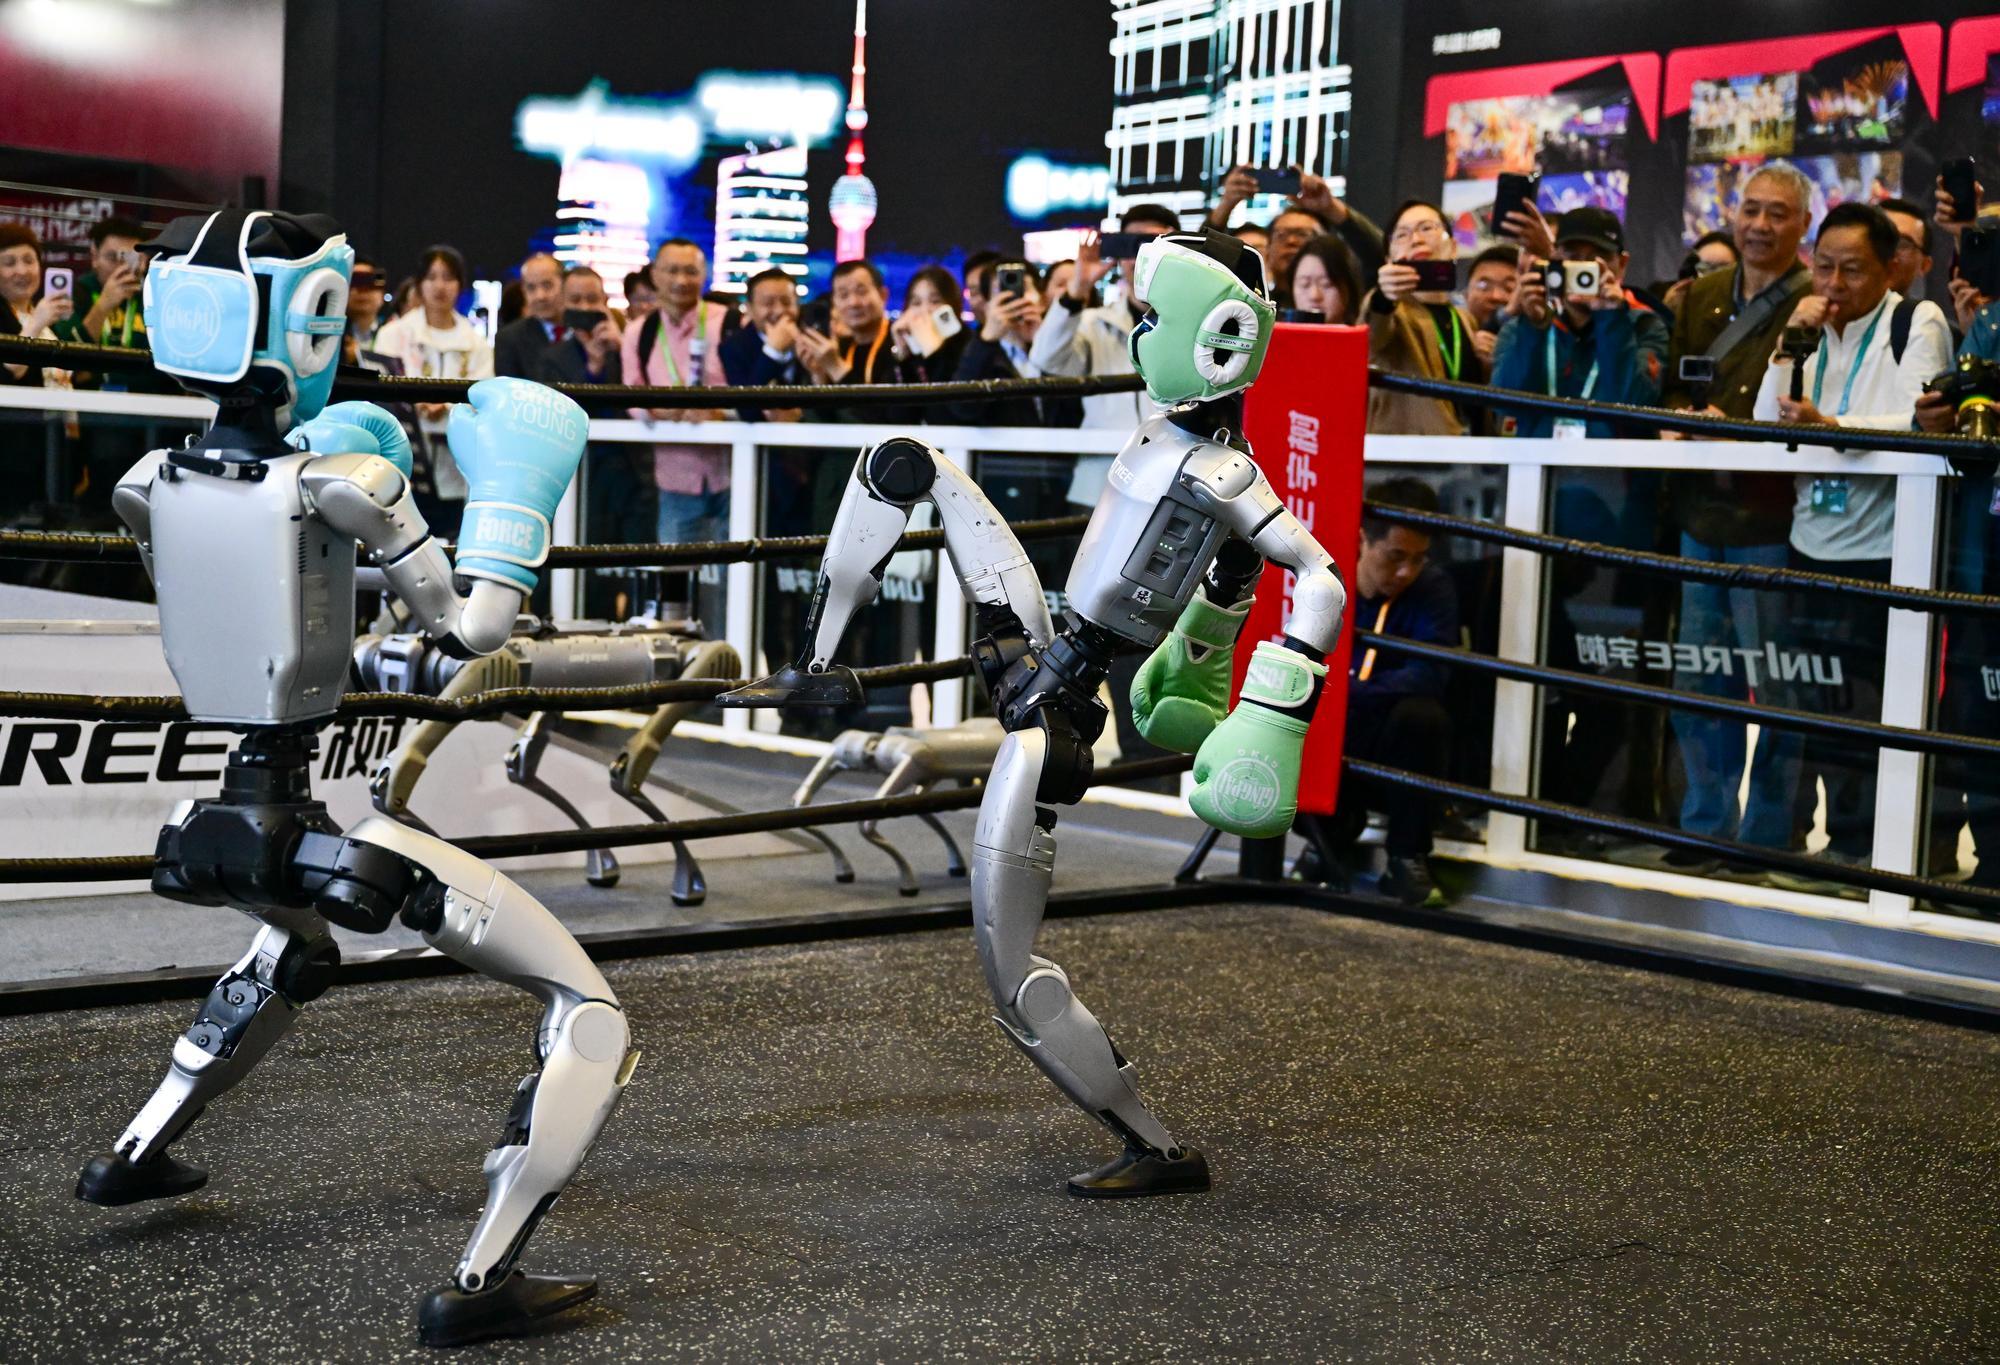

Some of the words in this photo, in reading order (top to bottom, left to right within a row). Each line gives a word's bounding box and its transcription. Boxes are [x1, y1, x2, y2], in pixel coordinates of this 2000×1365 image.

[1210, 337, 1237, 346] VERSION
[511, 400, 577, 441] YOUNG
[1286, 409, 1320, 493] 宇树
[475, 516, 535, 552] FORCE
[0, 722, 231, 787] REE
